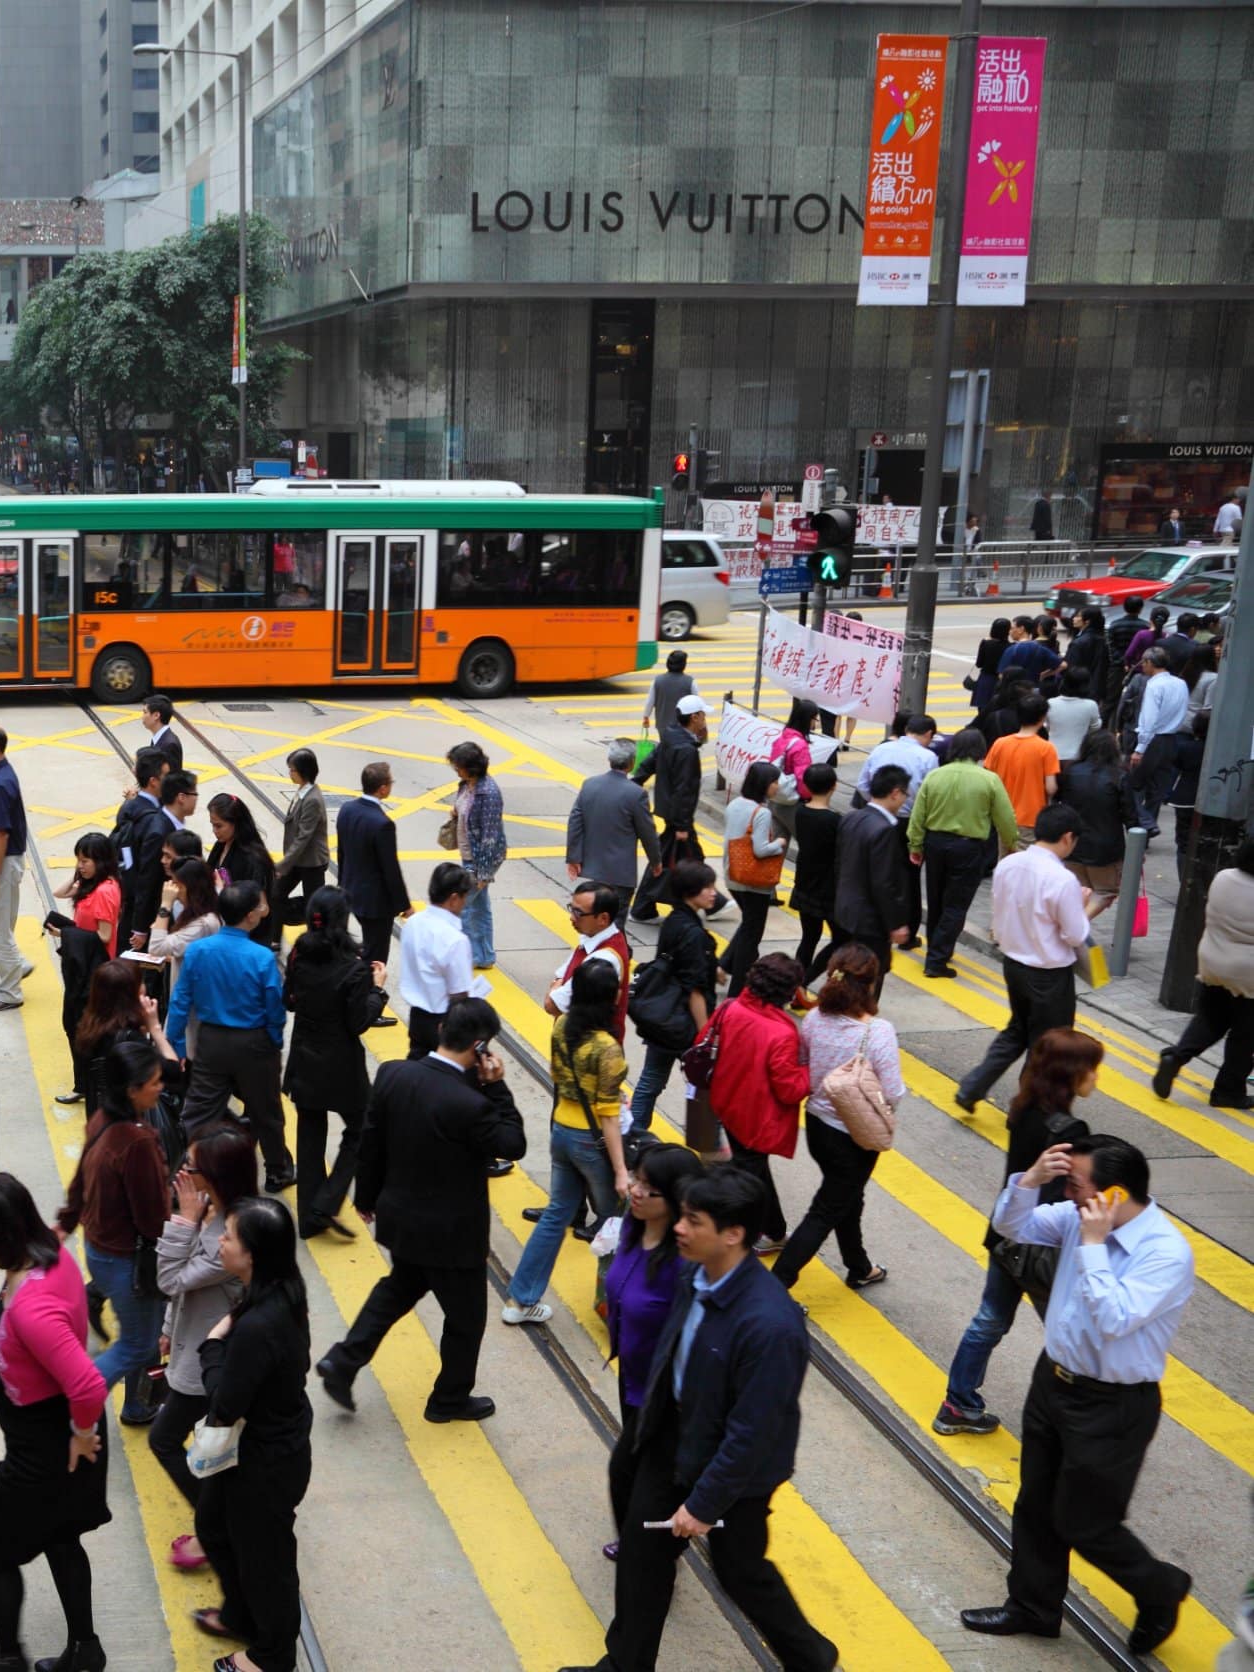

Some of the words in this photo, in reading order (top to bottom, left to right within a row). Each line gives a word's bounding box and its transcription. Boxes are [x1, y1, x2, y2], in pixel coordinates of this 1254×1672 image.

[979, 49, 1021, 73] 活出
[977, 70, 1029, 103] 融和
[976, 105, 988, 113] get
[989, 104, 1002, 112] into
[872, 152, 913, 175] 活出
[472, 190, 624, 233] LOUIS
[649, 191, 865, 235] VUITTON
[869, 206, 884, 215] get
[886, 205, 913, 215] going!
[1169, 446, 1202, 456] LOUIS
[1206, 445, 1253, 456] VUITTON
[734, 485, 757, 494] LOUIS
[94, 591, 119, 604] 15C
